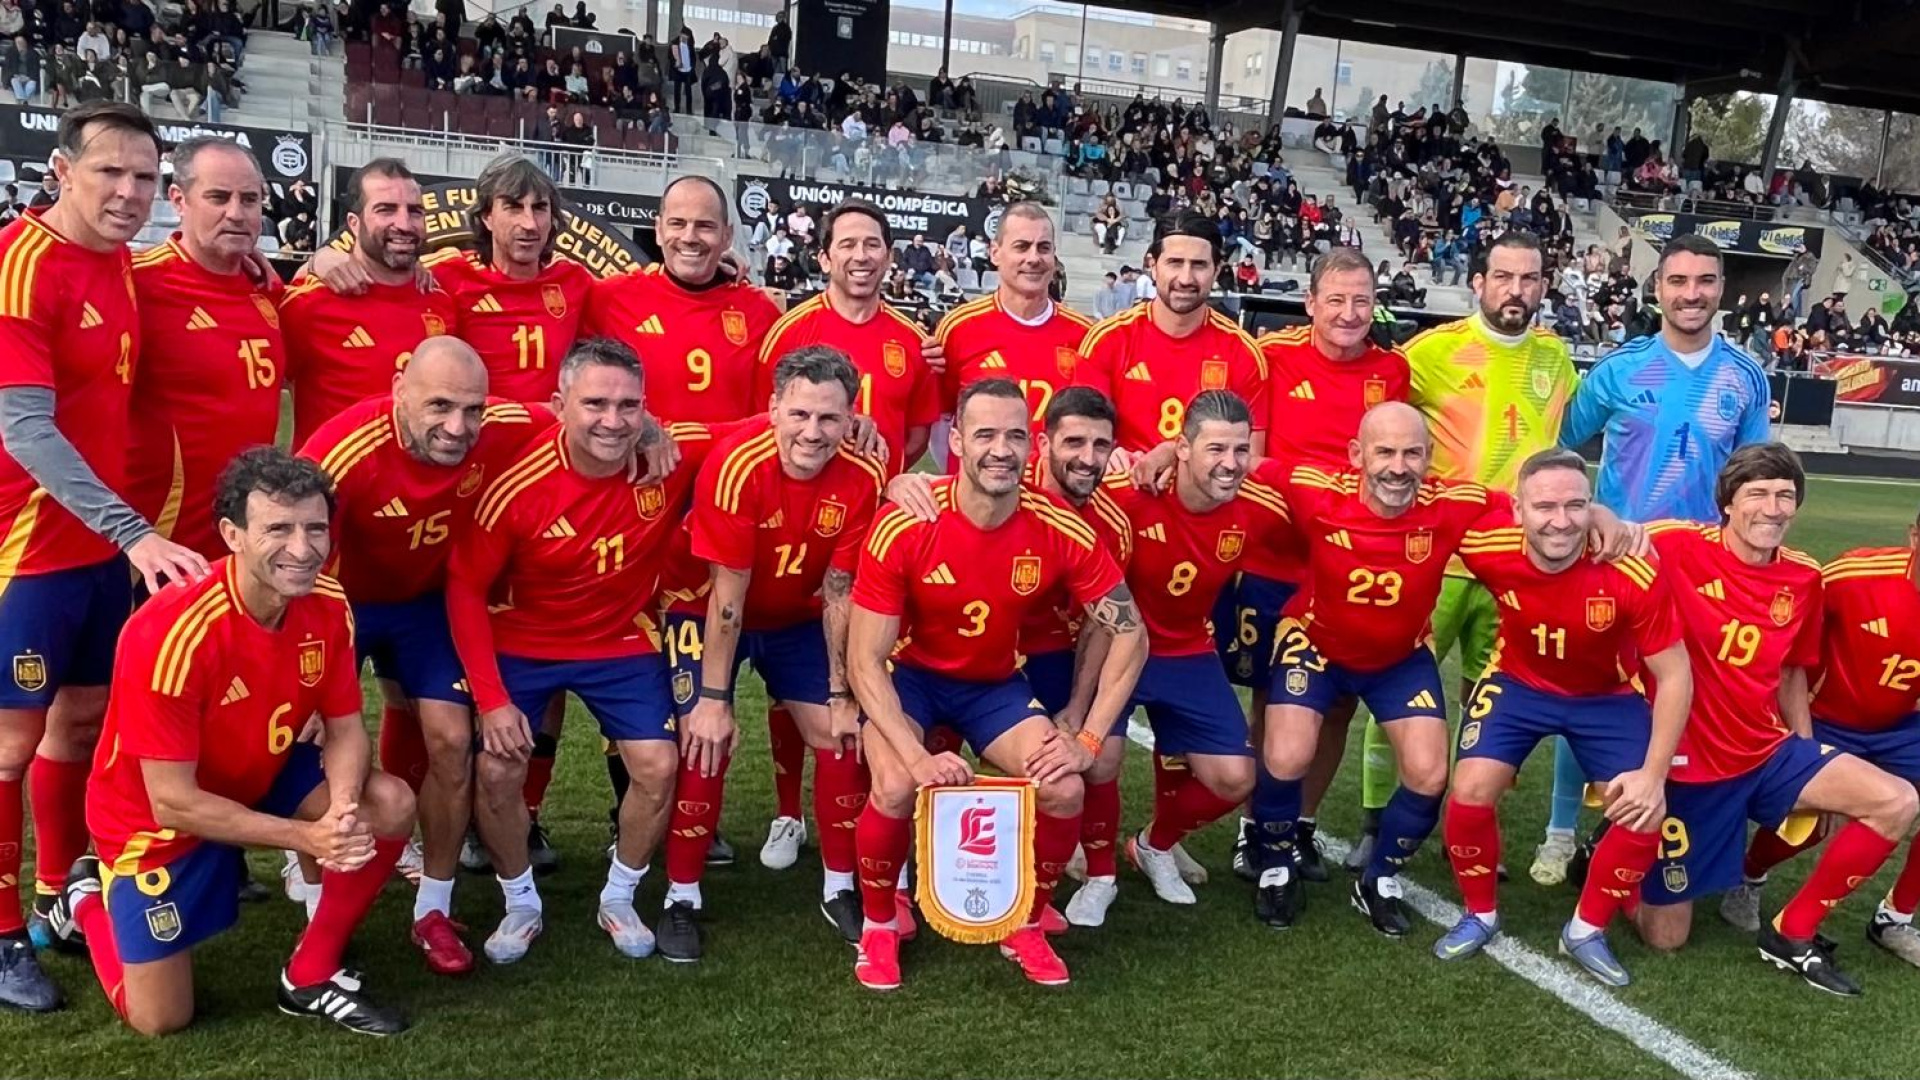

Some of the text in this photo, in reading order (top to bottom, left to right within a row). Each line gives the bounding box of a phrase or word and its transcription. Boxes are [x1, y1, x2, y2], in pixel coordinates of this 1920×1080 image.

[20, 112, 61, 131] UNI
[607, 201, 658, 219] CUENC
[789, 185, 845, 204] UNIÓN
[116, 331, 132, 384] 4
[238, 338, 276, 389] 15
[512, 325, 545, 369] 11
[686, 348, 712, 391] 9
[1157, 397, 1185, 439] 8
[1504, 404, 1517, 442] 1
[1675, 422, 1690, 459] 1
[406, 509, 451, 550] 15
[592, 533, 624, 574] 11
[1167, 561, 1198, 596] 8
[1347, 568, 1403, 606] 23
[958, 600, 990, 637] 3
[1240, 608, 1258, 646] 6
[664, 620, 703, 668] 14
[1531, 623, 1566, 659] 11
[1717, 618, 1761, 666] 19
[1879, 654, 1920, 691] 12
[268, 702, 293, 755] 6
